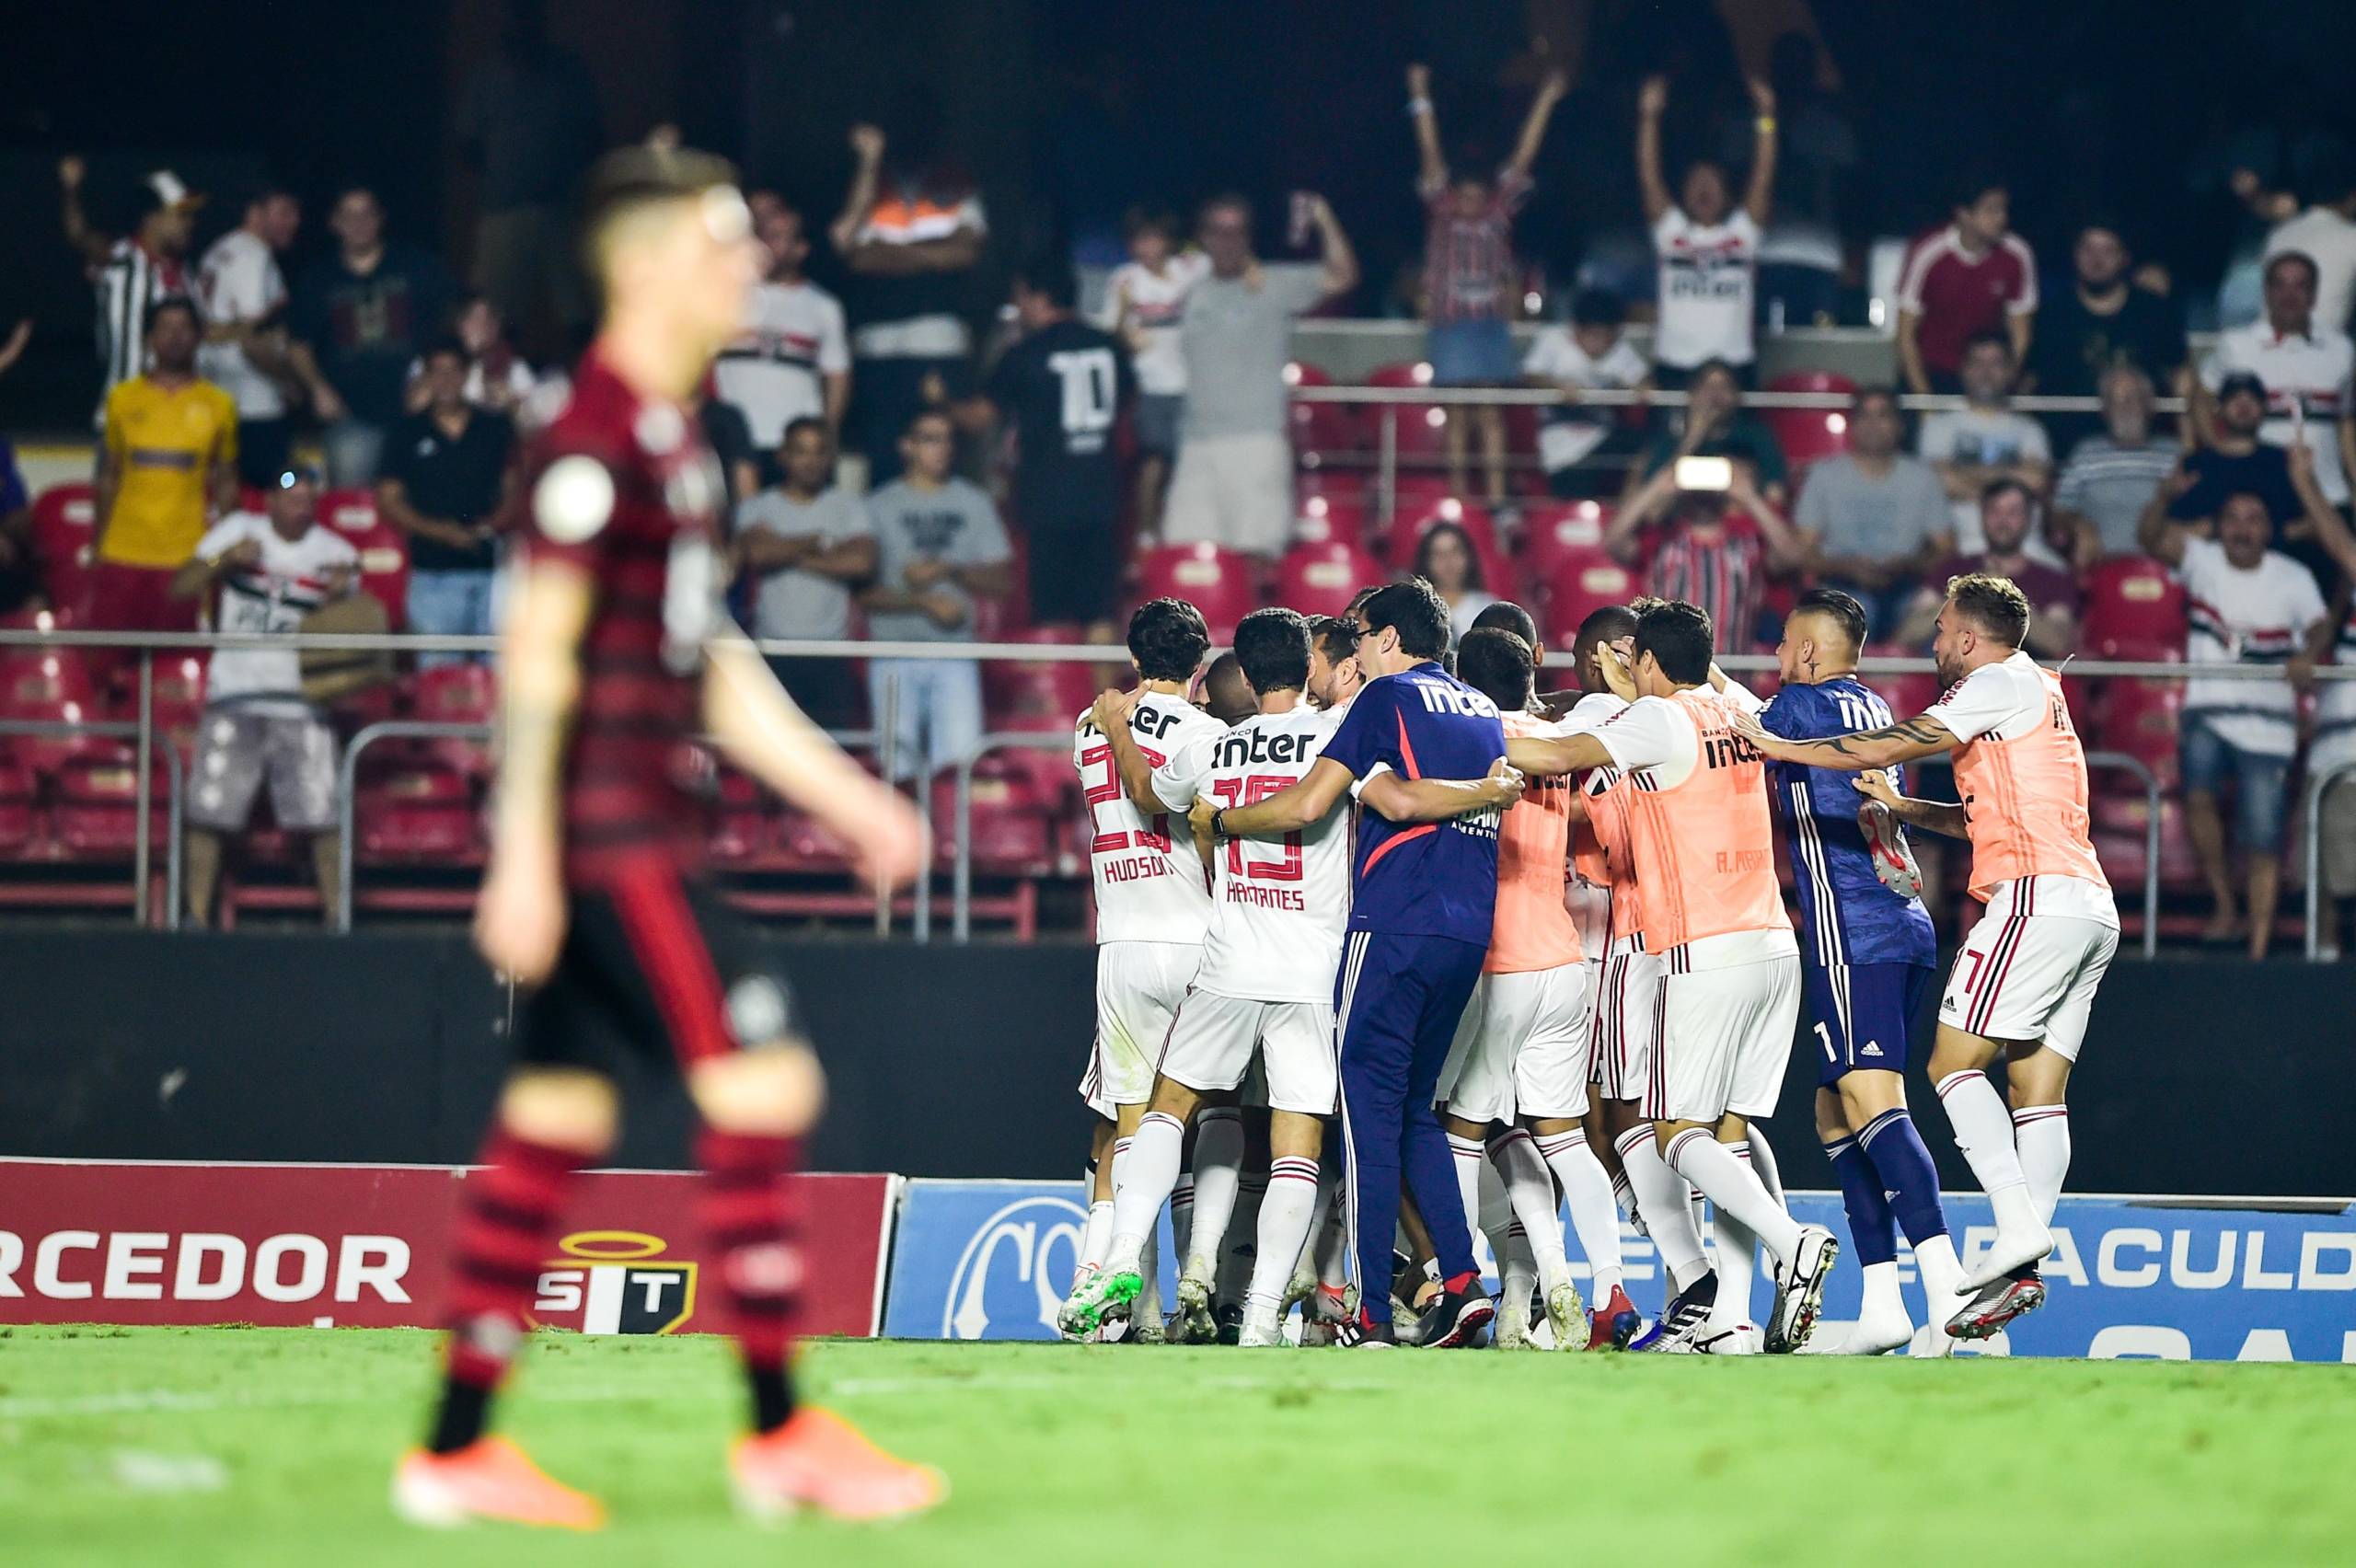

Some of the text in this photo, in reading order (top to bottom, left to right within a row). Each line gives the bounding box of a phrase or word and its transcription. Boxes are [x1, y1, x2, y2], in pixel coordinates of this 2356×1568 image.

[1048, 349, 1116, 431] 10
[1211, 726, 1316, 769] inter
[1813, 1020, 1838, 1064] 1
